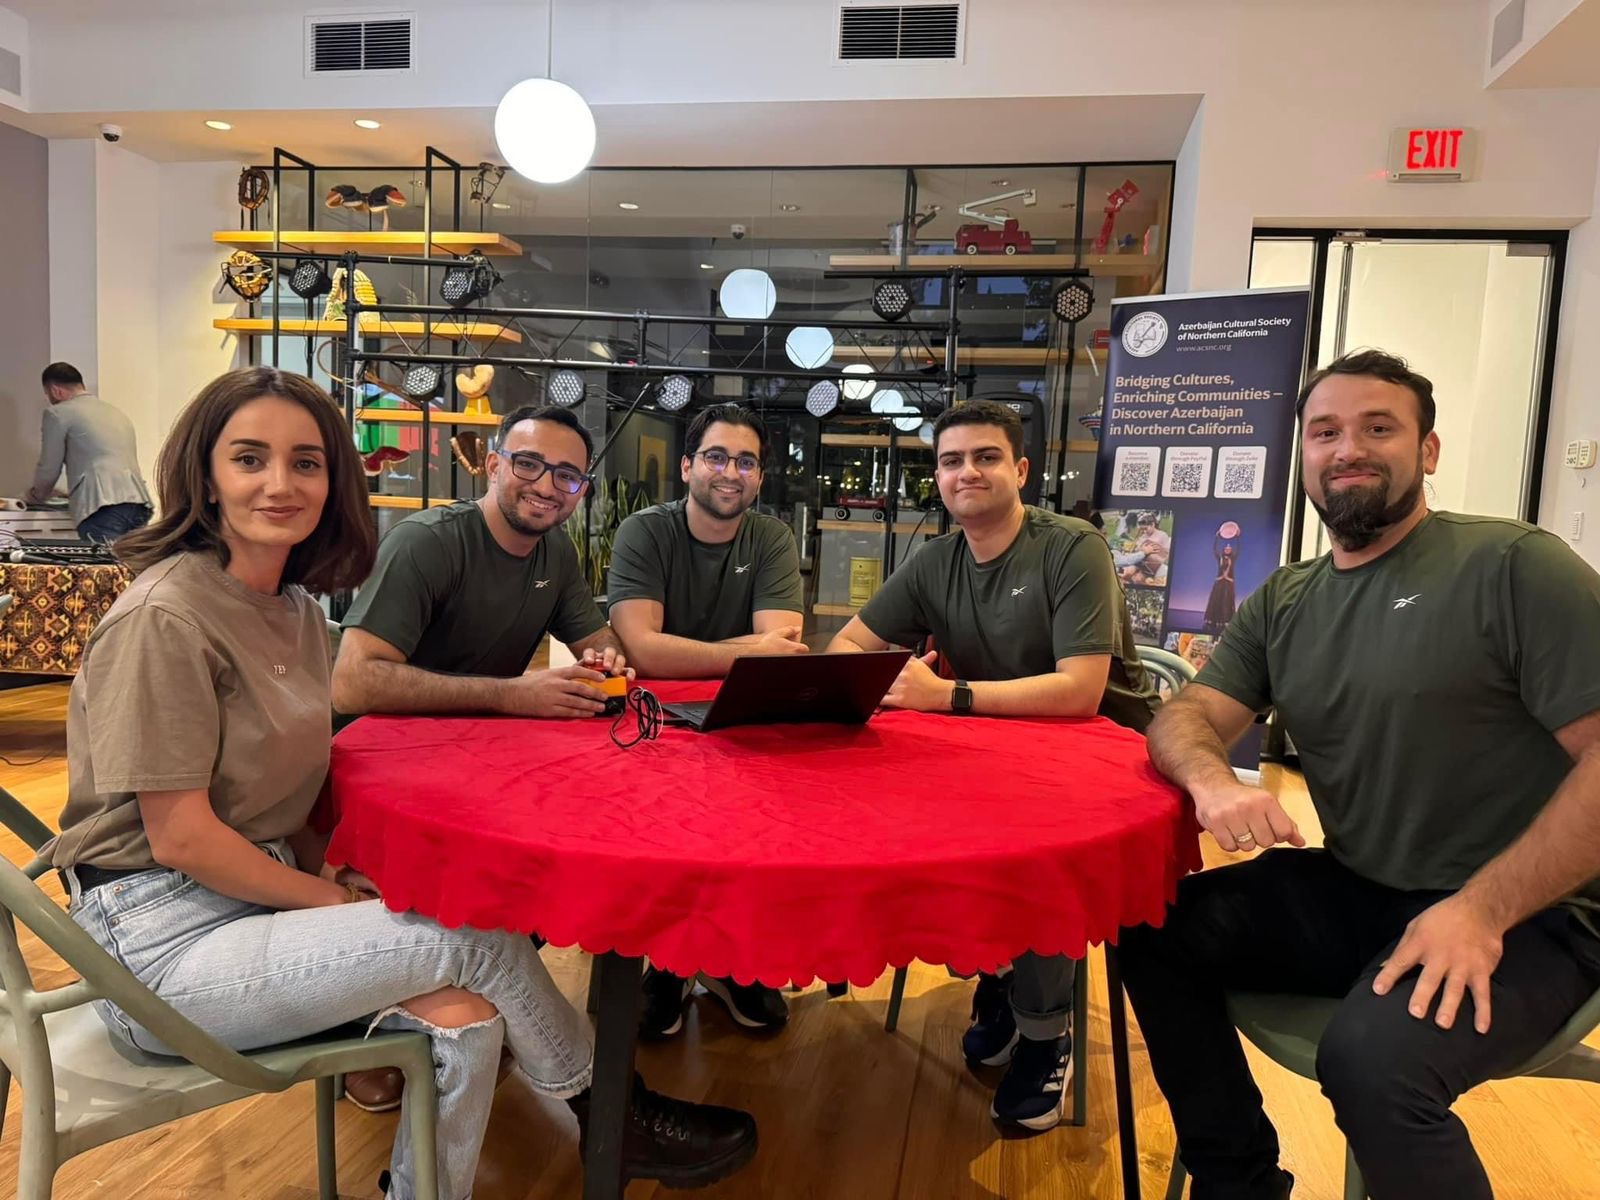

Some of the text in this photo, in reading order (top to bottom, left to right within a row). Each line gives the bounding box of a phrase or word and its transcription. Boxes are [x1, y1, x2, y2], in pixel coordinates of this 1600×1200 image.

[1406, 129, 1464, 170] EXIT
[1178, 317, 1292, 331] Azerbaijan Cultural Society
[1177, 328, 1268, 341] of Northern California
[1176, 344, 1232, 352] www.acsnc.org
[1115, 373, 1235, 390] Bridging Cultures,
[1113, 390, 1176, 405] Enriching
[1178, 388, 1271, 402] Communities
[1111, 405, 1243, 420] Discover Azerbaijan
[1109, 421, 1254, 435] in Northern California
